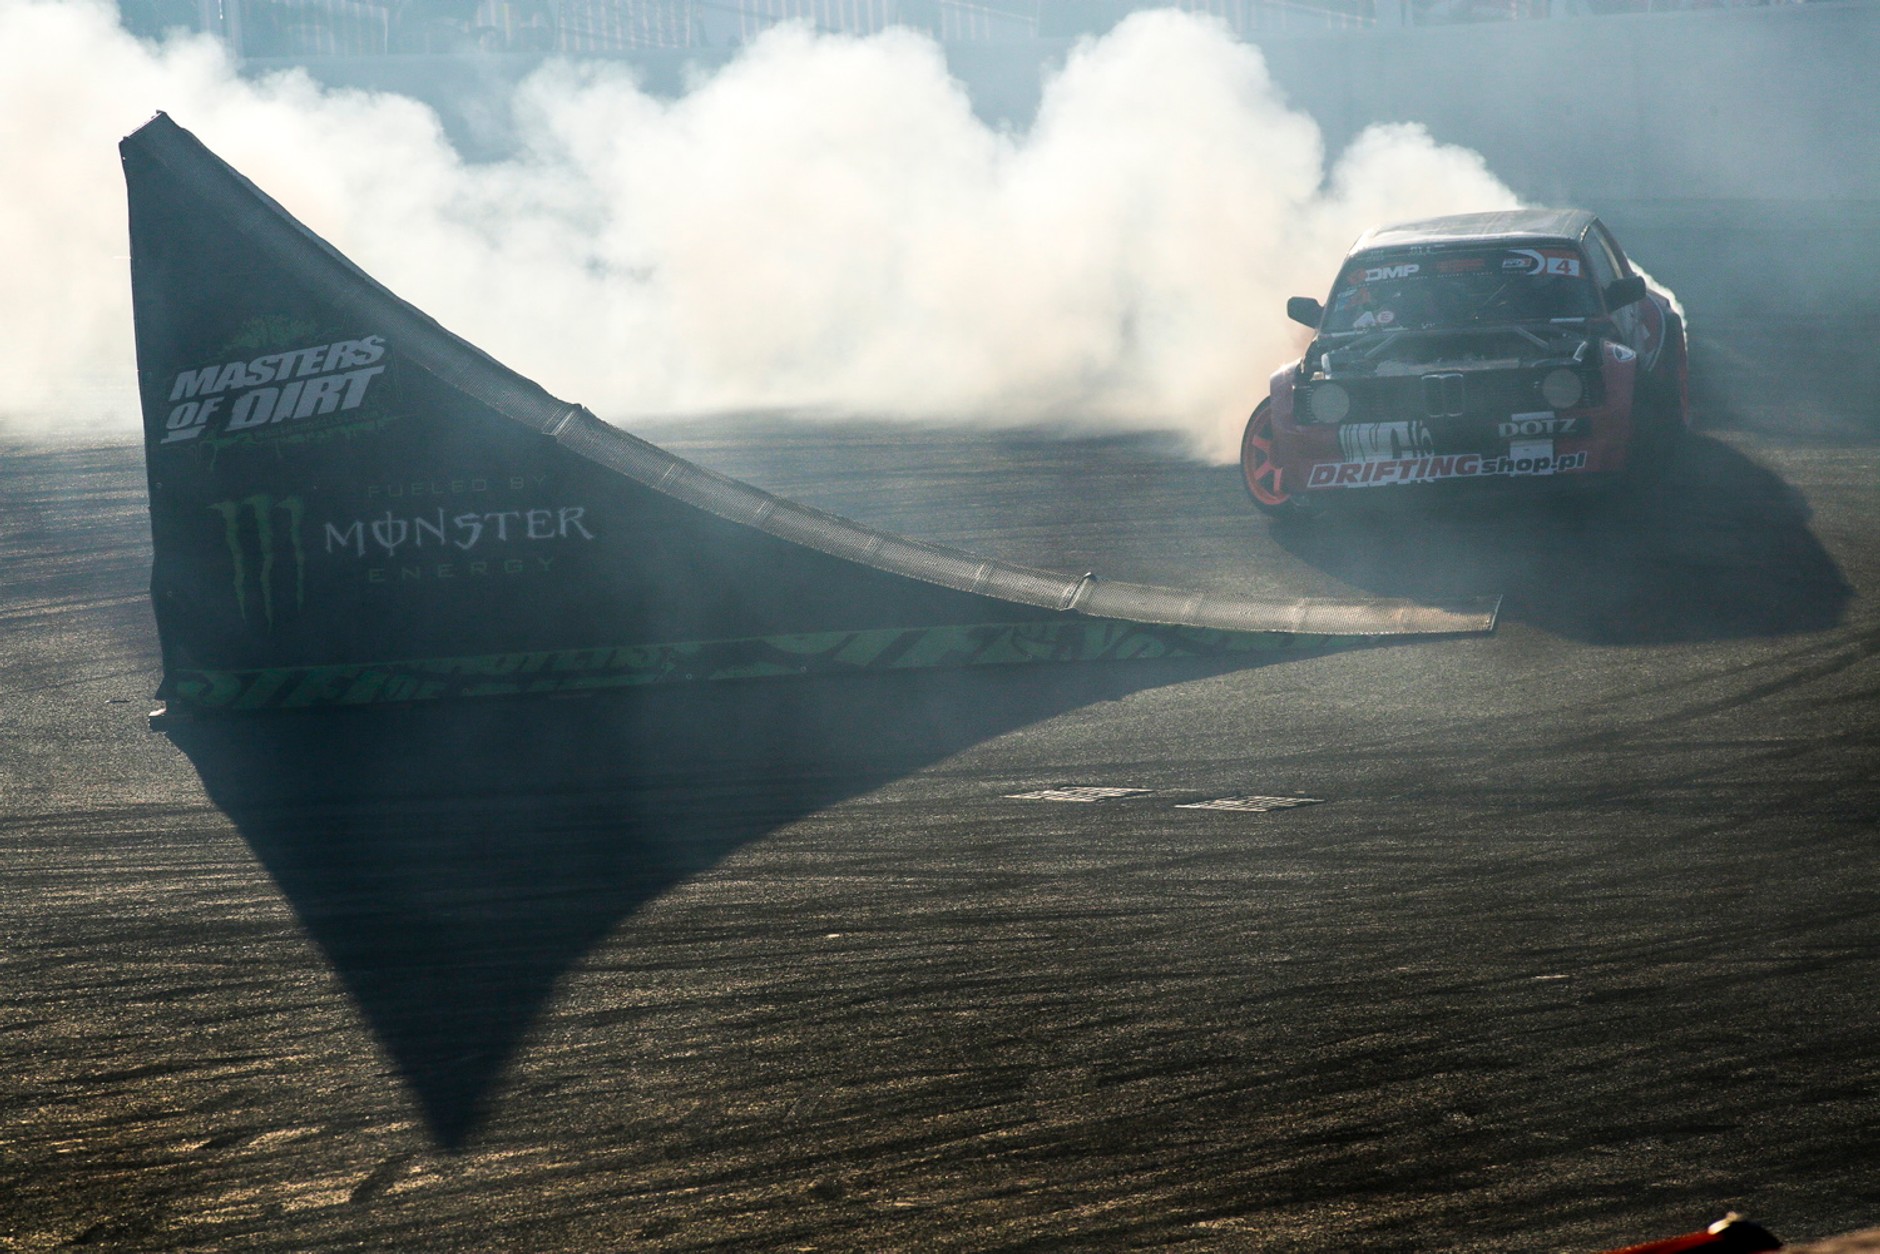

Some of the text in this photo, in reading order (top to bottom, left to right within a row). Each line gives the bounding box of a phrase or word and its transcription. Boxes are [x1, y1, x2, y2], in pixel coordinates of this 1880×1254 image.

[1364, 263, 1420, 282] DMP
[1555, 259, 1571, 273] 4
[168, 334, 386, 402] MASTERS
[165, 396, 226, 430] OF
[224, 365, 386, 433] DIRT
[1497, 418, 1577, 438] DOTZ
[1308, 451, 1588, 487] DRIFTINGshop.pl
[367, 473, 547, 498] FUELED BY
[323, 506, 595, 557] MONSTER
[368, 556, 554, 583] ENERGY
